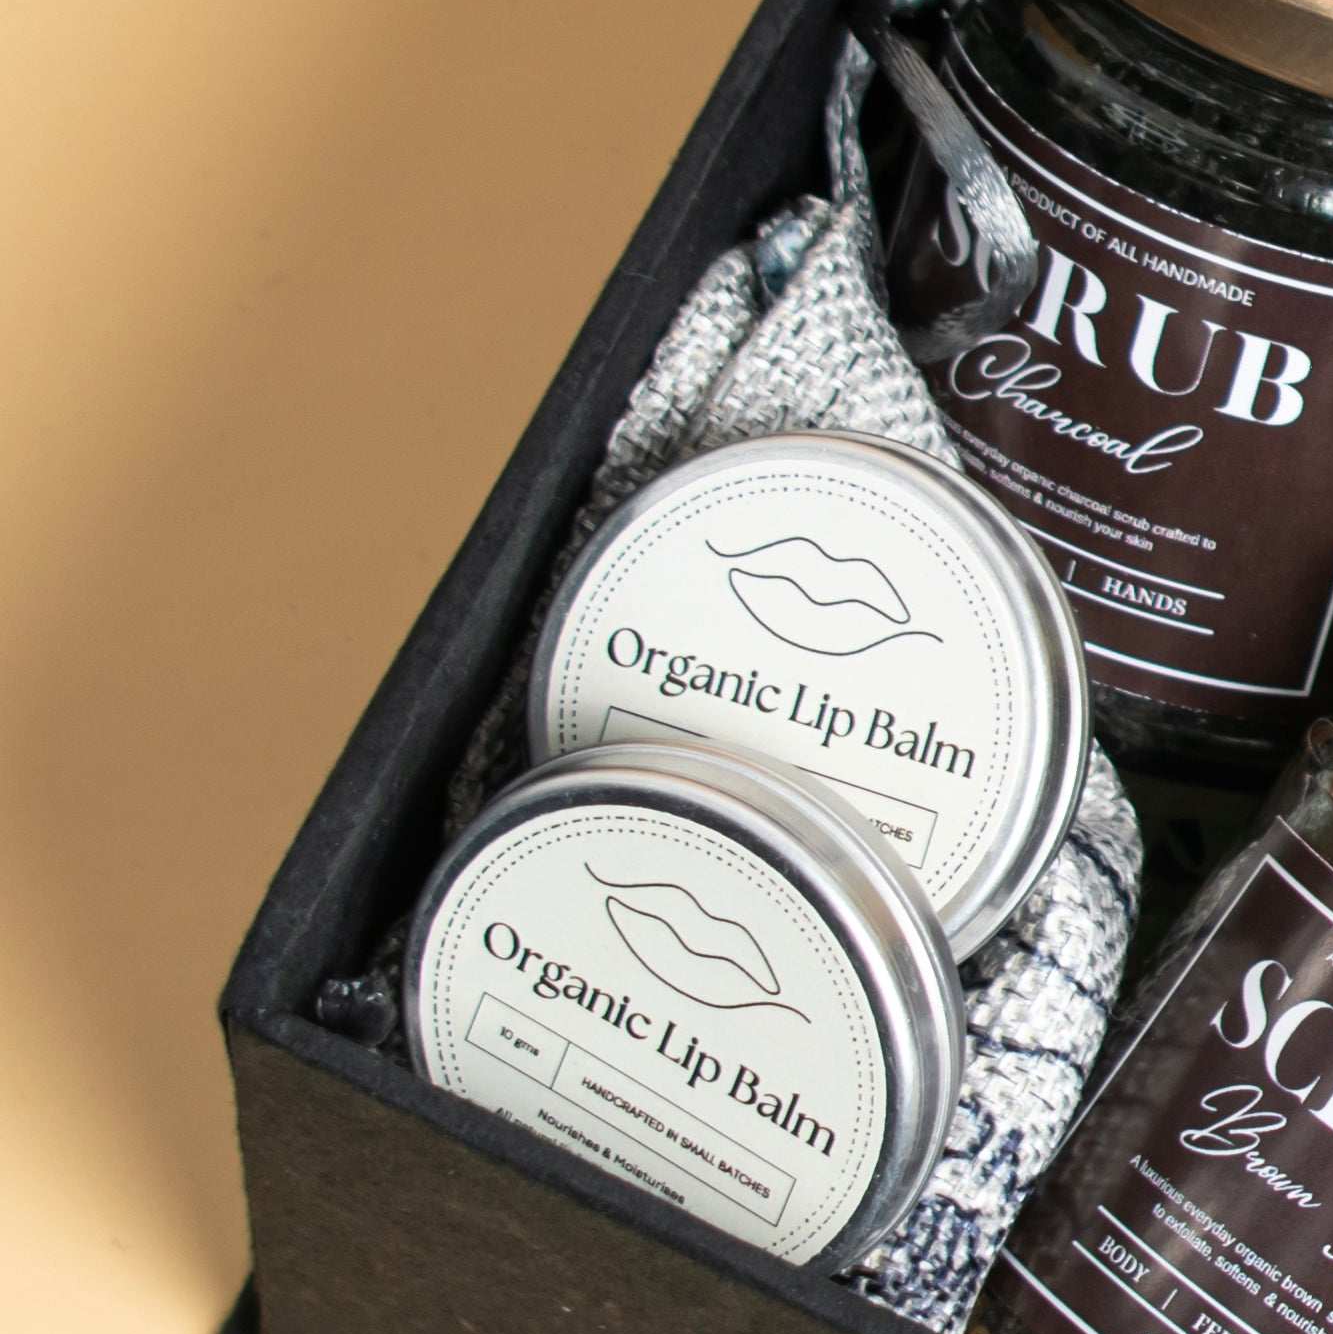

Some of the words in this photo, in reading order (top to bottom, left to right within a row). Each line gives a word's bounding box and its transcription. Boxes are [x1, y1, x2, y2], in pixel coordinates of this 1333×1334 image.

[1011, 171, 1080, 231] PRODUCT
[1080, 221, 1106, 245] OF
[1106, 237, 1140, 264] ALL
[1141, 249, 1257, 308] HANDMADE
[949, 332, 1205, 475] Charcoal
[1102, 574, 1188, 617] HANDS
[605, 627, 780, 715] Organic
[787, 683, 855, 749] Lip
[863, 707, 976, 780] Balm
[482, 921, 650, 1040] Organic
[656, 1020, 723, 1088] Lip
[727, 1063, 836, 1158] Balm
[536, 1108, 601, 1153] Nourishes
[613, 1153, 686, 1206] Moisturises
[580, 1076, 666, 1134] HANDCRAFTED
[666, 1127, 680, 1142] IN
[680, 1136, 717, 1166] SMALL
[717, 1158, 771, 1200] BATCHES
[1179, 1084, 1322, 1210] Brown
[1098, 1234, 1152, 1285] BODY
[1181, 1198, 1238, 1249] everyday
[1233, 1240, 1282, 1284] organic
[1280, 1274, 1324, 1315] brown
[1213, 1253, 1261, 1297] softens
